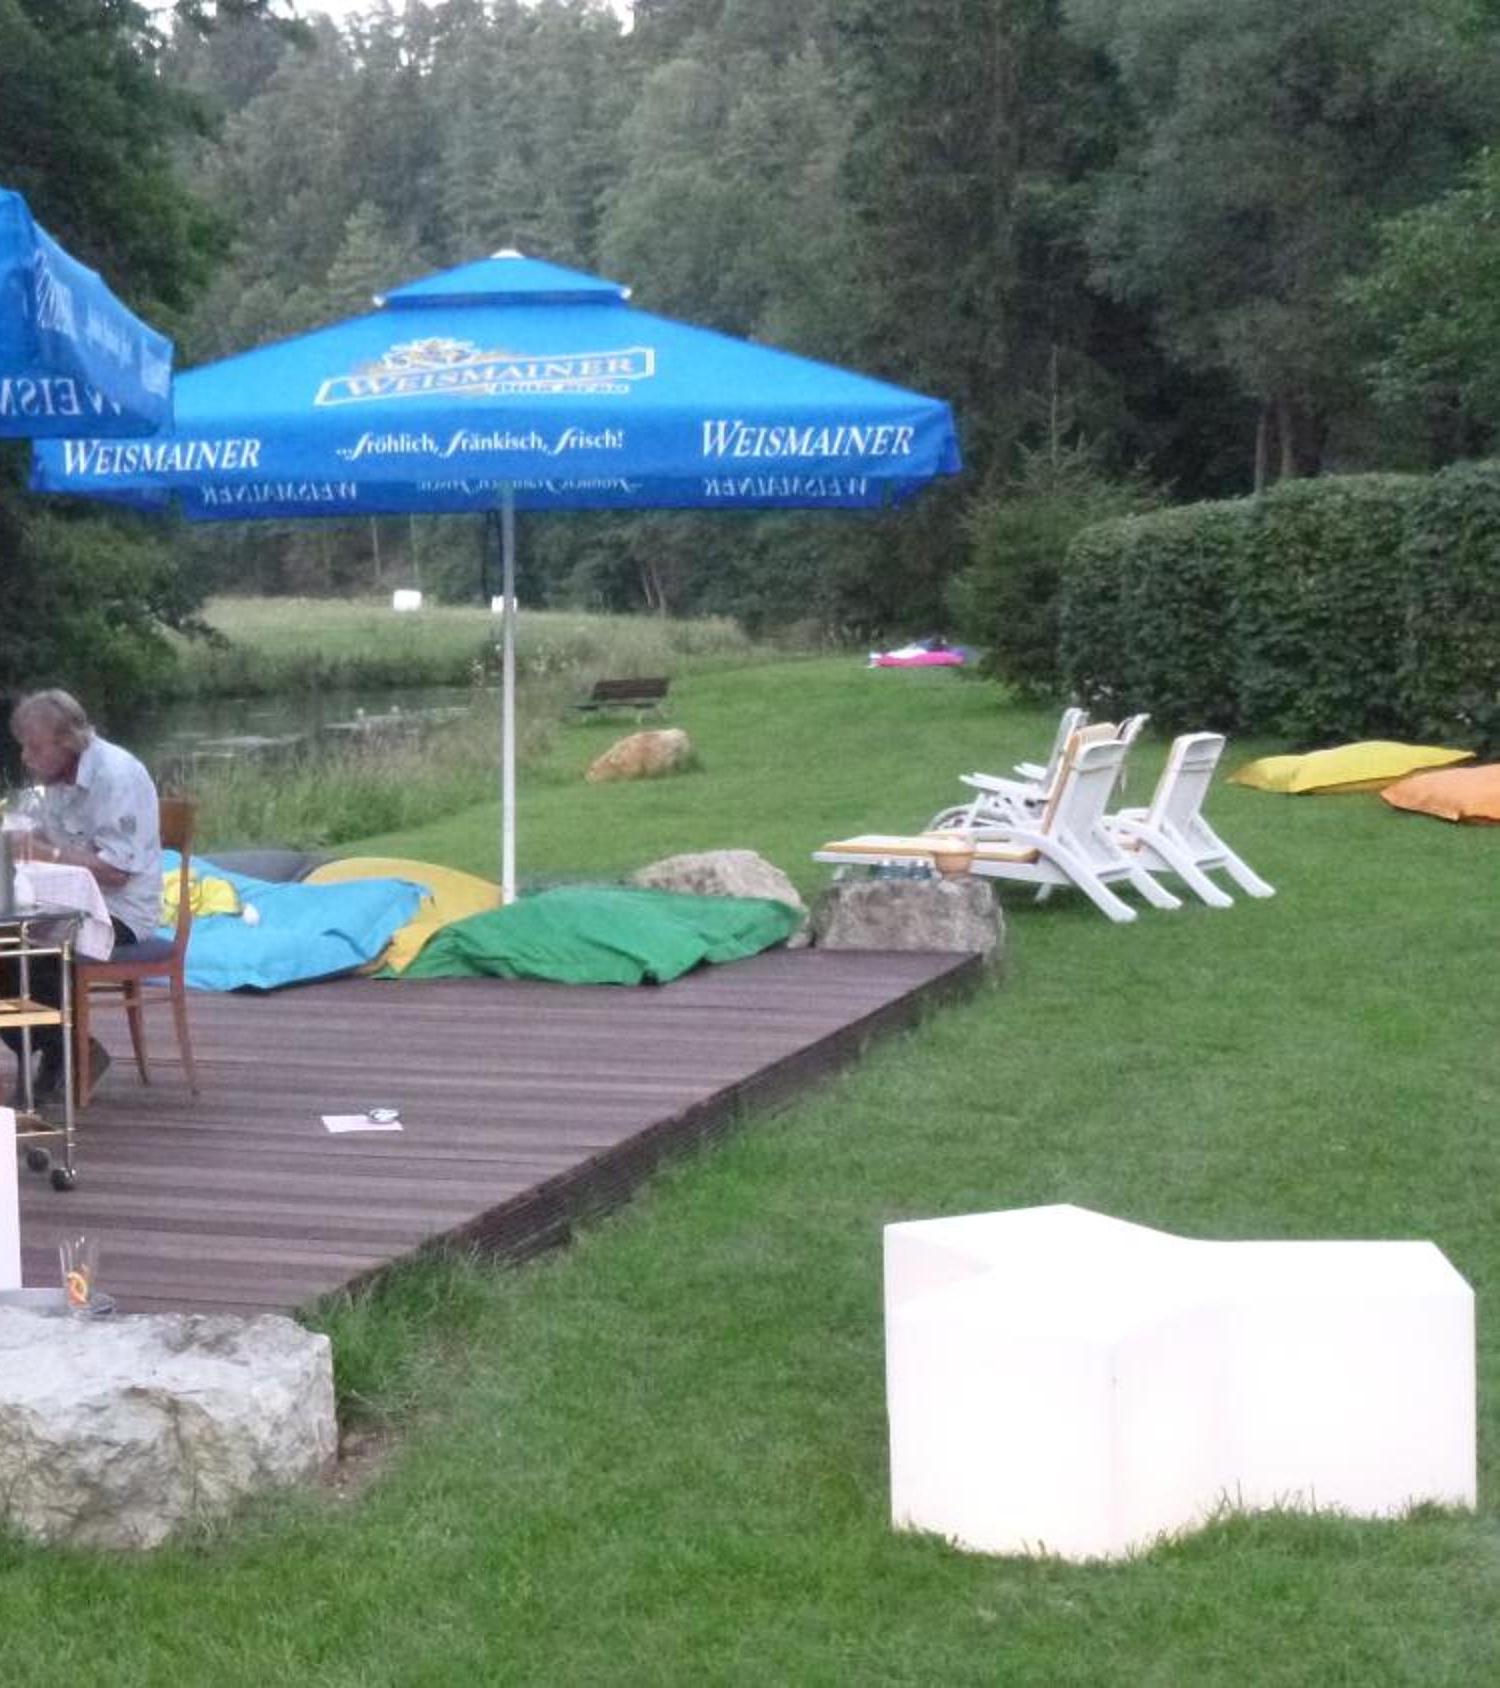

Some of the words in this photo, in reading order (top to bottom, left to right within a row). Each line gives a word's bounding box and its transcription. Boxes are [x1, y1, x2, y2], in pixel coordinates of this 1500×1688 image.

[347, 356, 635, 397] WEISMAINER
[62, 438, 261, 476] WEISMAINER
[438, 429, 549, 459] fränkisch,
[548, 426, 625, 456] frisch!
[702, 418, 915, 458] WEISMAINER
